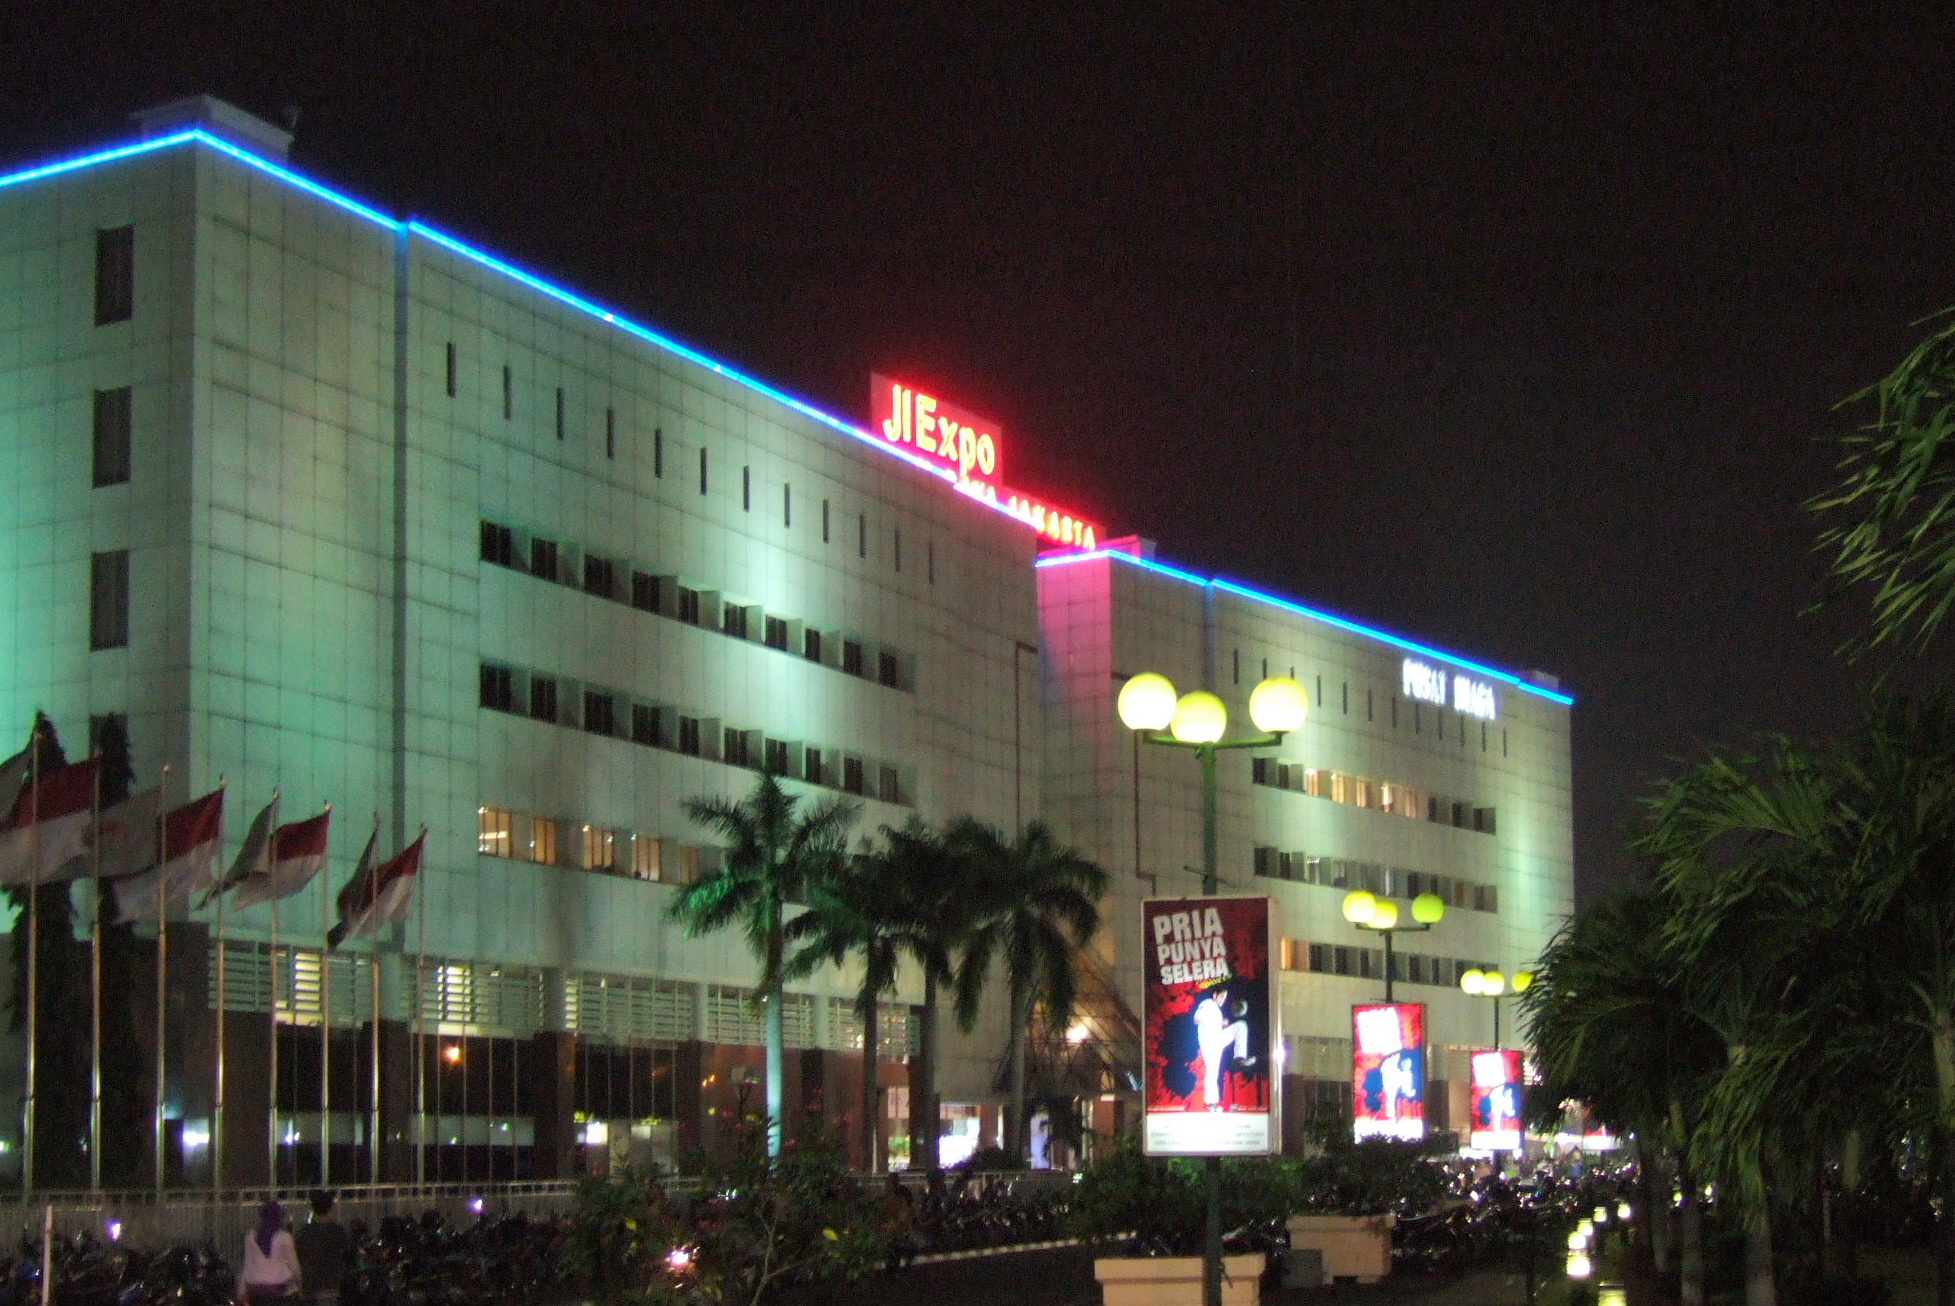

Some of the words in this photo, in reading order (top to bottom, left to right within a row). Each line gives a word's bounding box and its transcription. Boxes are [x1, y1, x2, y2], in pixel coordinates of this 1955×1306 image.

[882, 384, 996, 476] JIExpo
[1153, 907, 1224, 944] PRIA
[1157, 937, 1227, 965] PUNYA
[1160, 957, 1229, 985] SELERA
